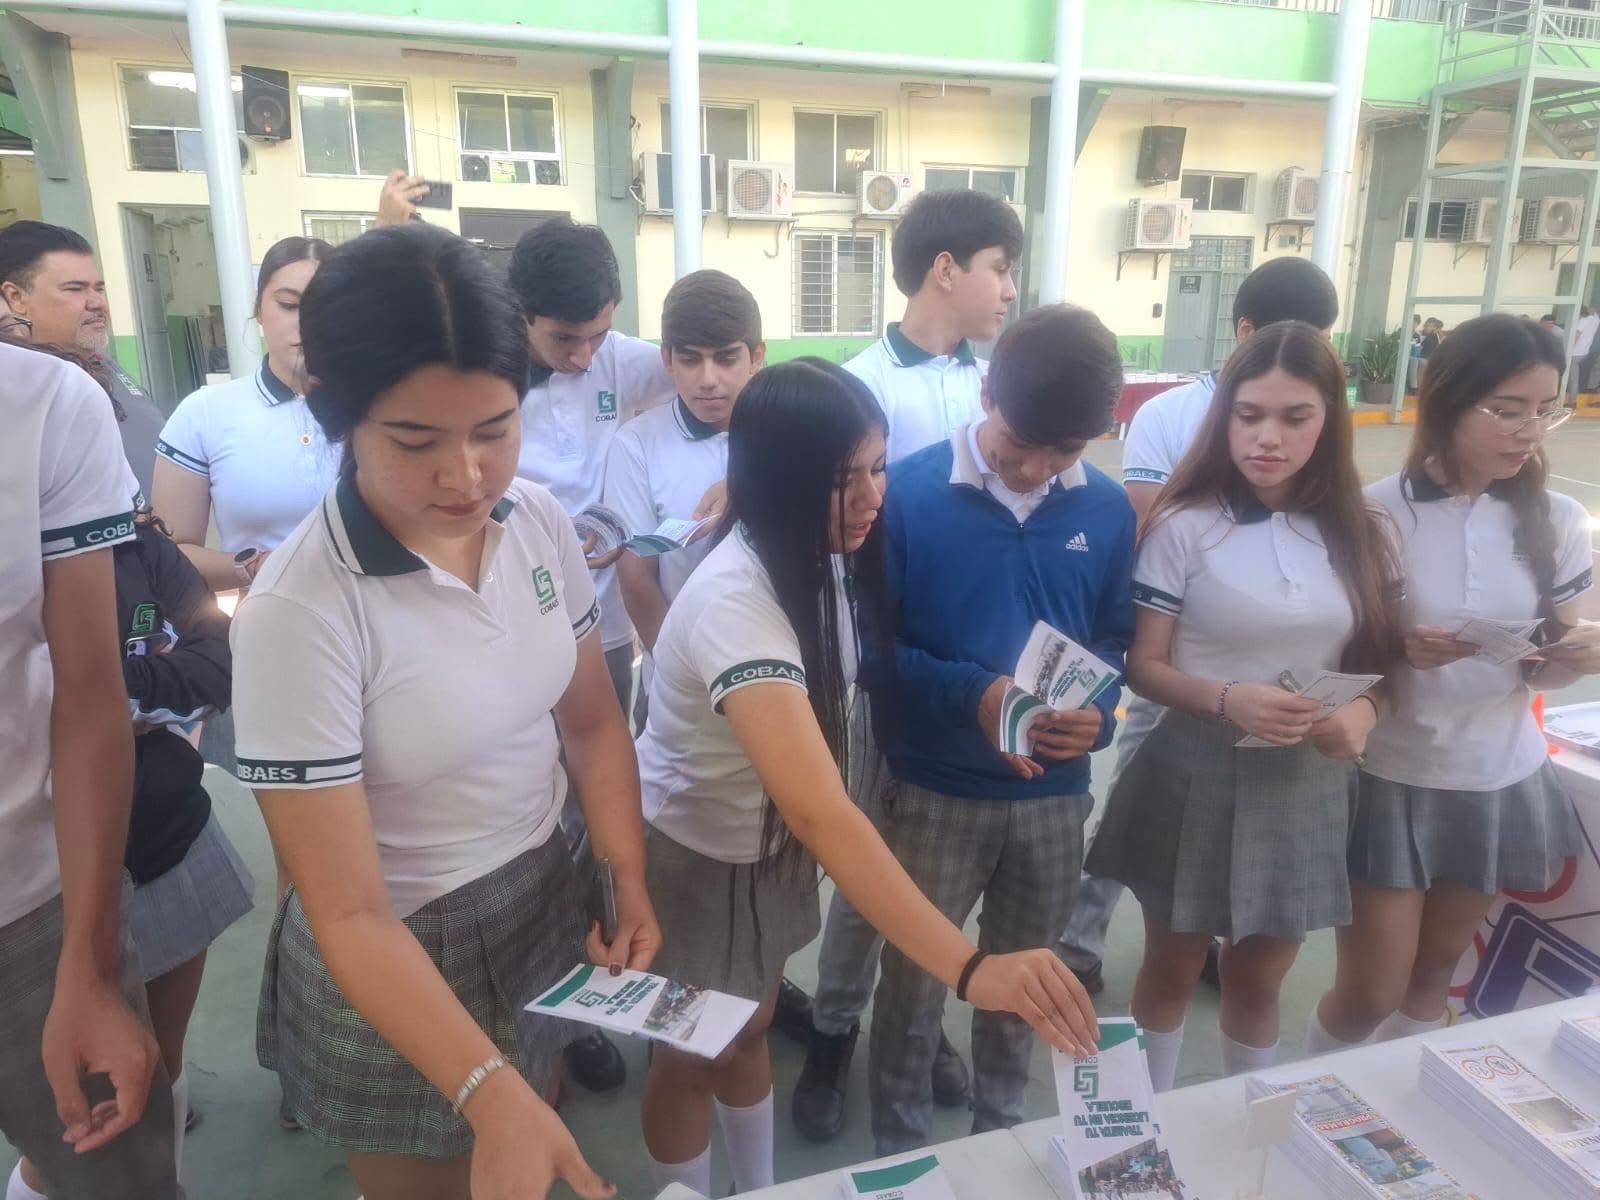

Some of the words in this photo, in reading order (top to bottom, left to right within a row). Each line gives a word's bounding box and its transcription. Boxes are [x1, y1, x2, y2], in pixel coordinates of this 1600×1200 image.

[1065, 544, 1088, 552] adidas
[1084, 1100, 1133, 1112] ESCUELA
[1074, 1114, 1088, 1126] TU
[1103, 1111, 1149, 1124] LICENCIA
[1085, 1127, 1099, 1138] TU
[1098, 1124, 1143, 1137] TRAMITA
